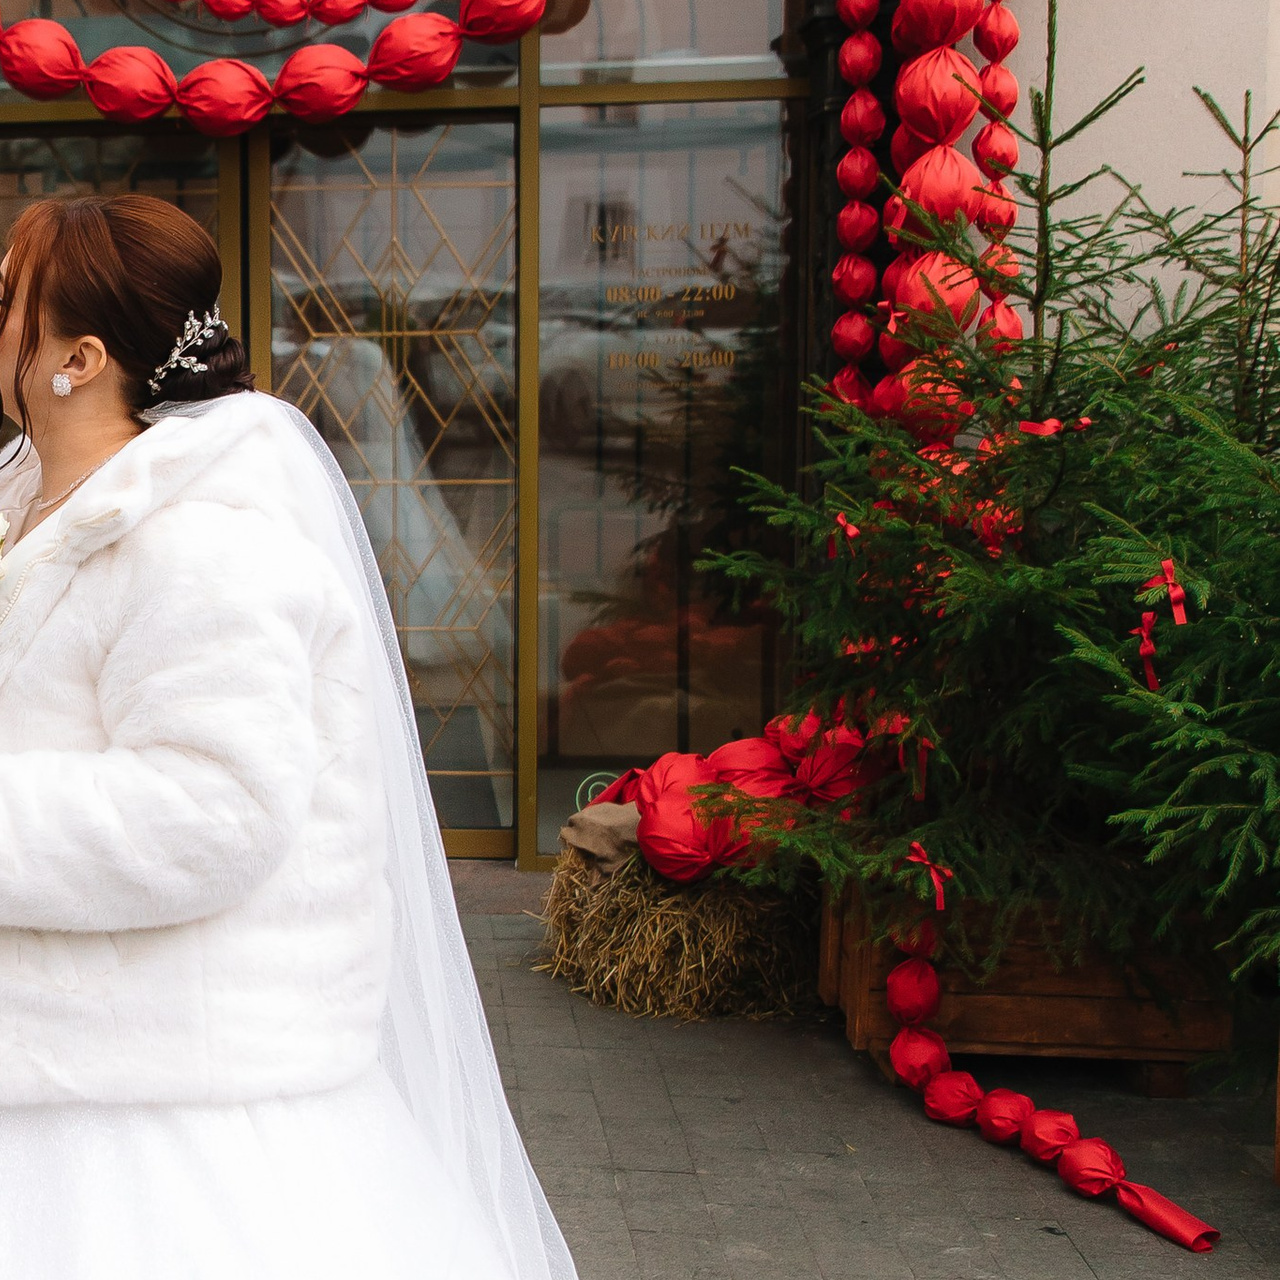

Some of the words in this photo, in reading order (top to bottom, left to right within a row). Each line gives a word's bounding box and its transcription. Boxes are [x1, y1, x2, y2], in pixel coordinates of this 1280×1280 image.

[605, 284, 662, 303] 08:00
[681, 282, 736, 302] 22:00
[609, 351, 660, 370] 10:00
[680, 350, 735, 368] 20:00
